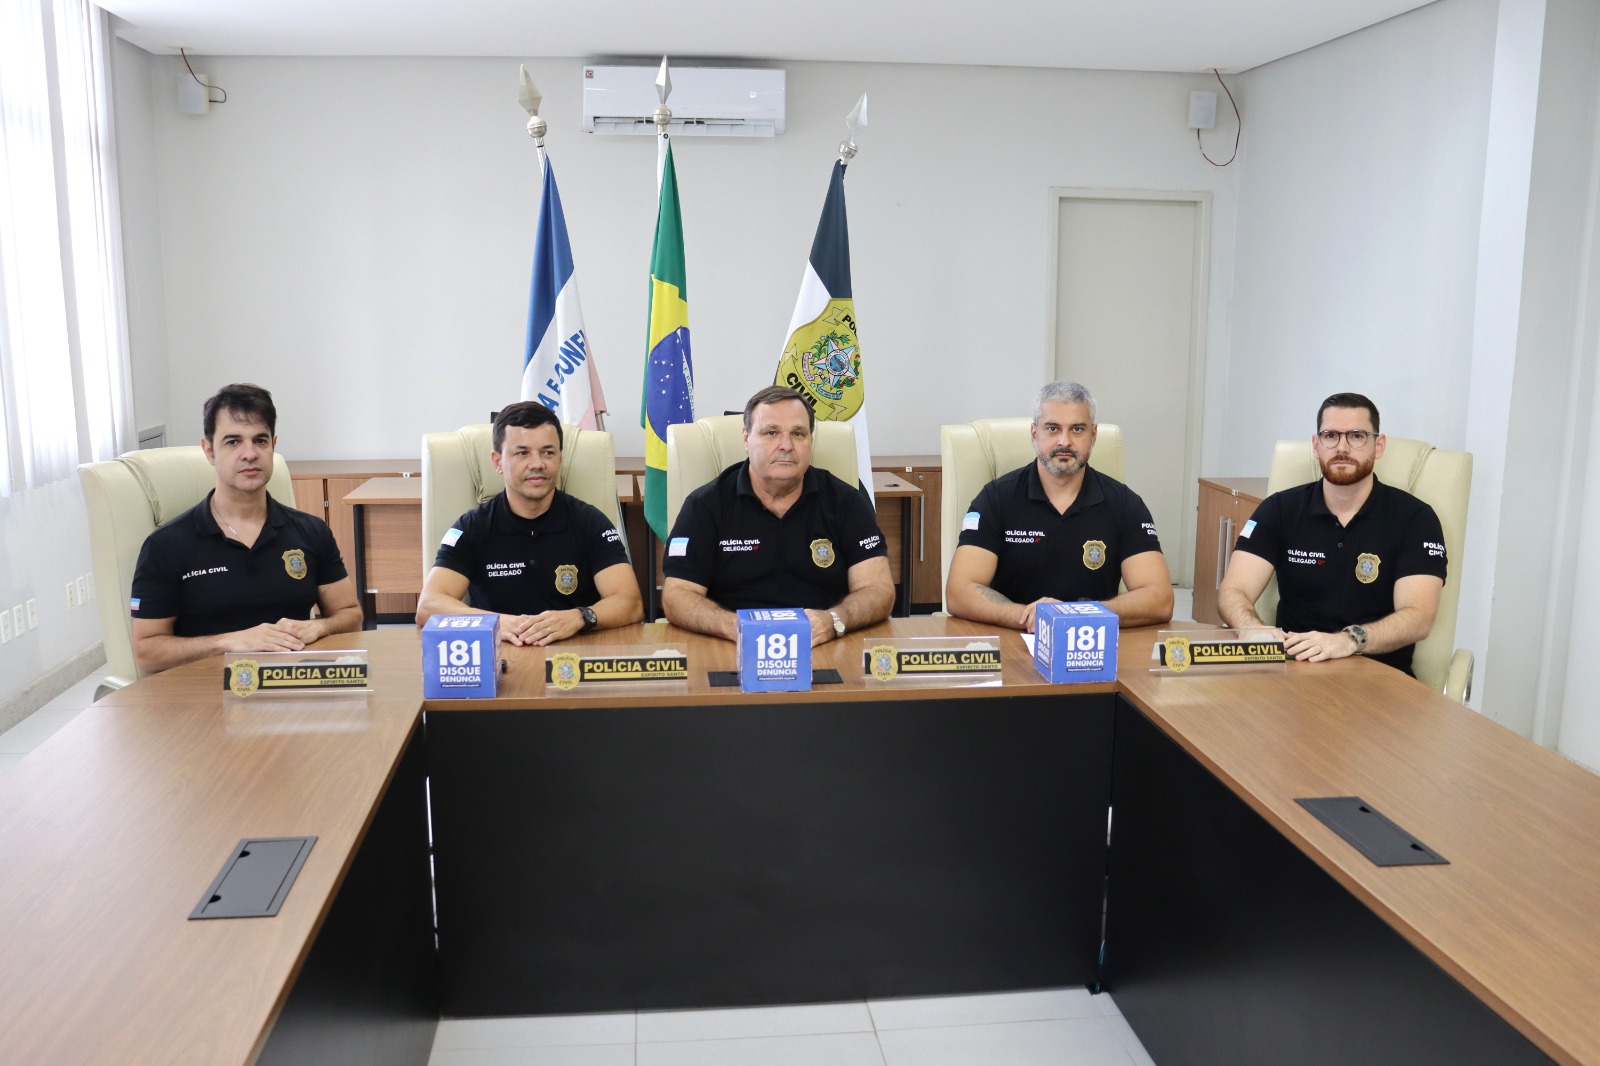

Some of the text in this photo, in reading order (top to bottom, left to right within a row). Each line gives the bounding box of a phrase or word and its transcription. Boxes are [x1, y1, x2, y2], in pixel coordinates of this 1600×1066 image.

[1287, 549, 1308, 557] OLÍCIA
[208, 566, 229, 574] CIVIL
[488, 569, 522, 578] DELEGADO
[1065, 625, 1106, 651] 181
[755, 633, 798, 660] 181
[1193, 643, 1282, 657] POLÍCIA CIVIL
[437, 640, 481, 667] 181
[901, 651, 998, 665] POLÍCIA CIVIL
[1066, 651, 1105, 660] DISQUE
[584, 659, 685, 673] POLÍCIA CIVIL
[757, 659, 798, 669] DISQUE
[1066, 659, 1104, 667] DENÚNCIA
[262, 666, 365, 680] POLÍCIA CIVIL
[440, 666, 481, 676] DISQUE
[757, 668, 797, 676] DENÚNCIA
[440, 674, 481, 683] DENÚNCIA
